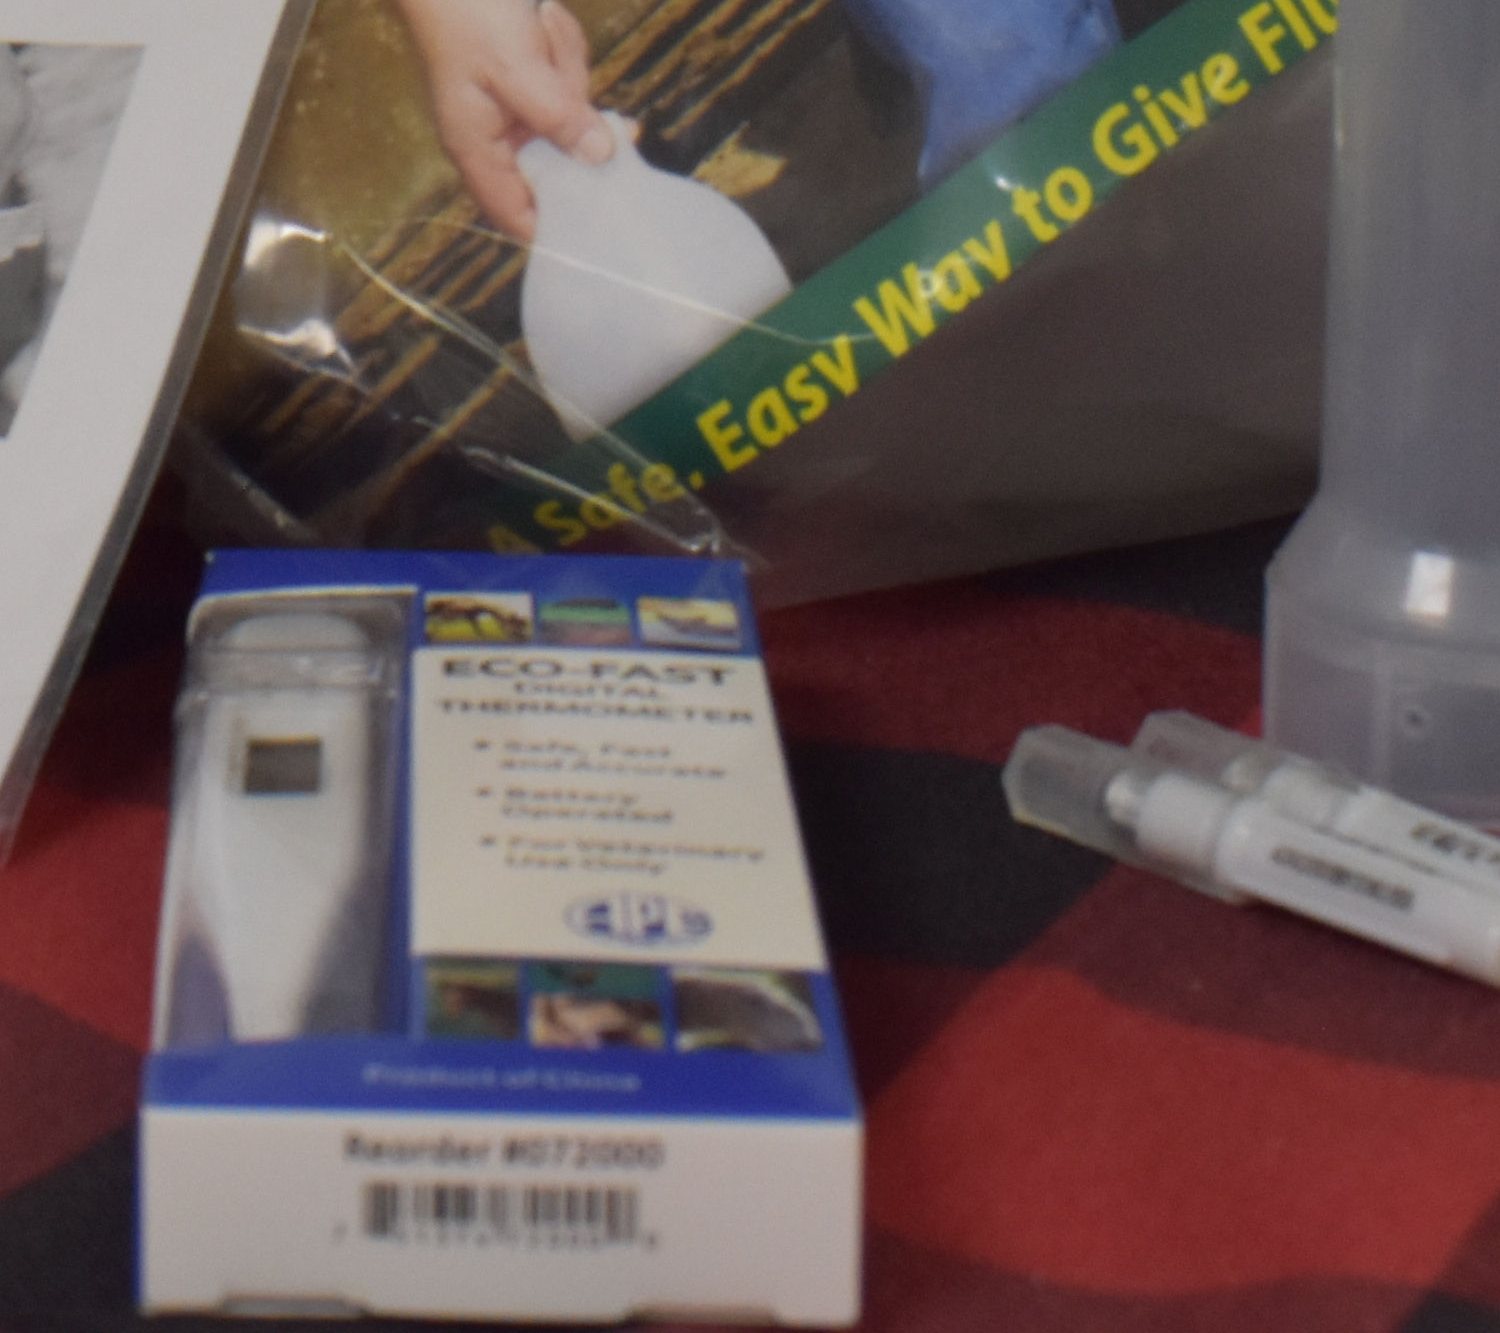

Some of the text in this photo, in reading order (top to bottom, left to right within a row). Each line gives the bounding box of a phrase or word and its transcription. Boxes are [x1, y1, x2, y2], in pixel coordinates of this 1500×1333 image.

[696, 336, 861, 474] Easy
[854, 218, 1013, 359] Way
[1012, 163, 1094, 244] to
[1091, 49, 1251, 178] Give
[441, 658, 736, 686] ECO-FAST
[438, 698, 754, 724] THERMOMETER
